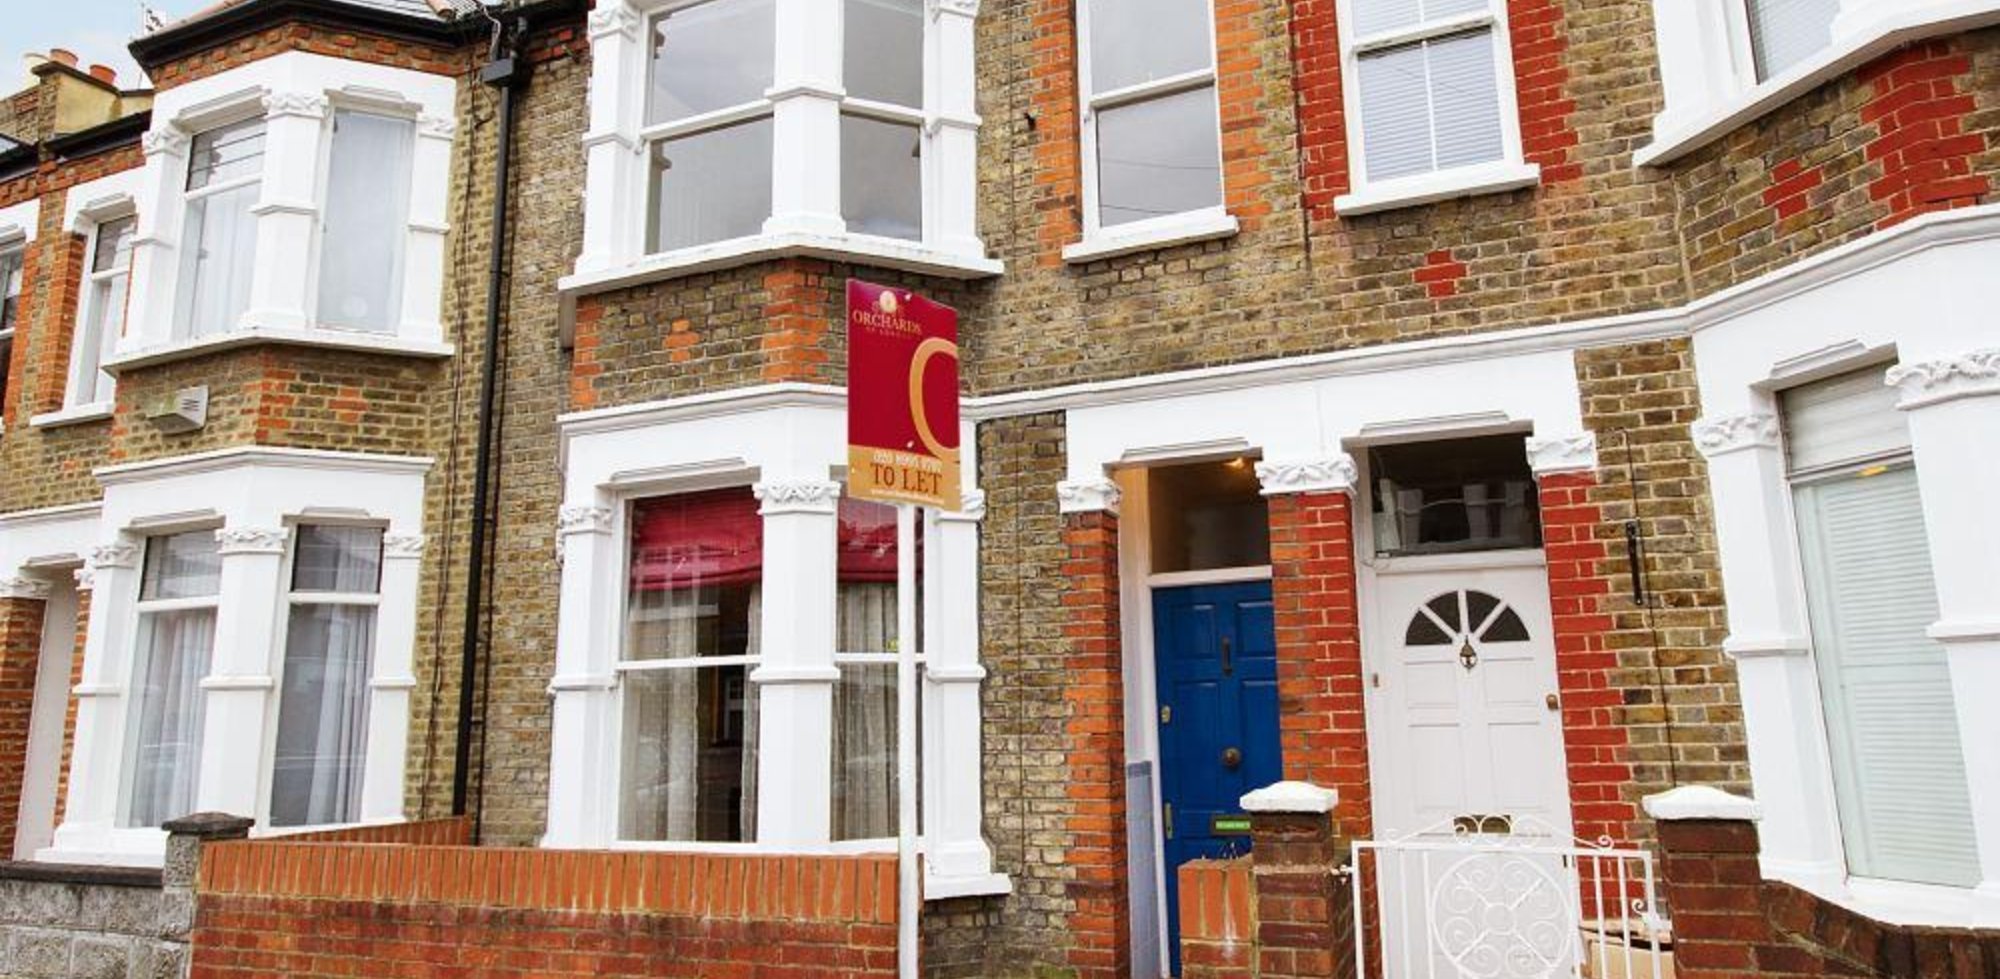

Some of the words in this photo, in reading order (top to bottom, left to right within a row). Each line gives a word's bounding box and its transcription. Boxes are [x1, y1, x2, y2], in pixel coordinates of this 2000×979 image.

[852, 309, 922, 335] ORCHARDS
[870, 461, 895, 487] TO
[901, 468, 943, 496] LET
